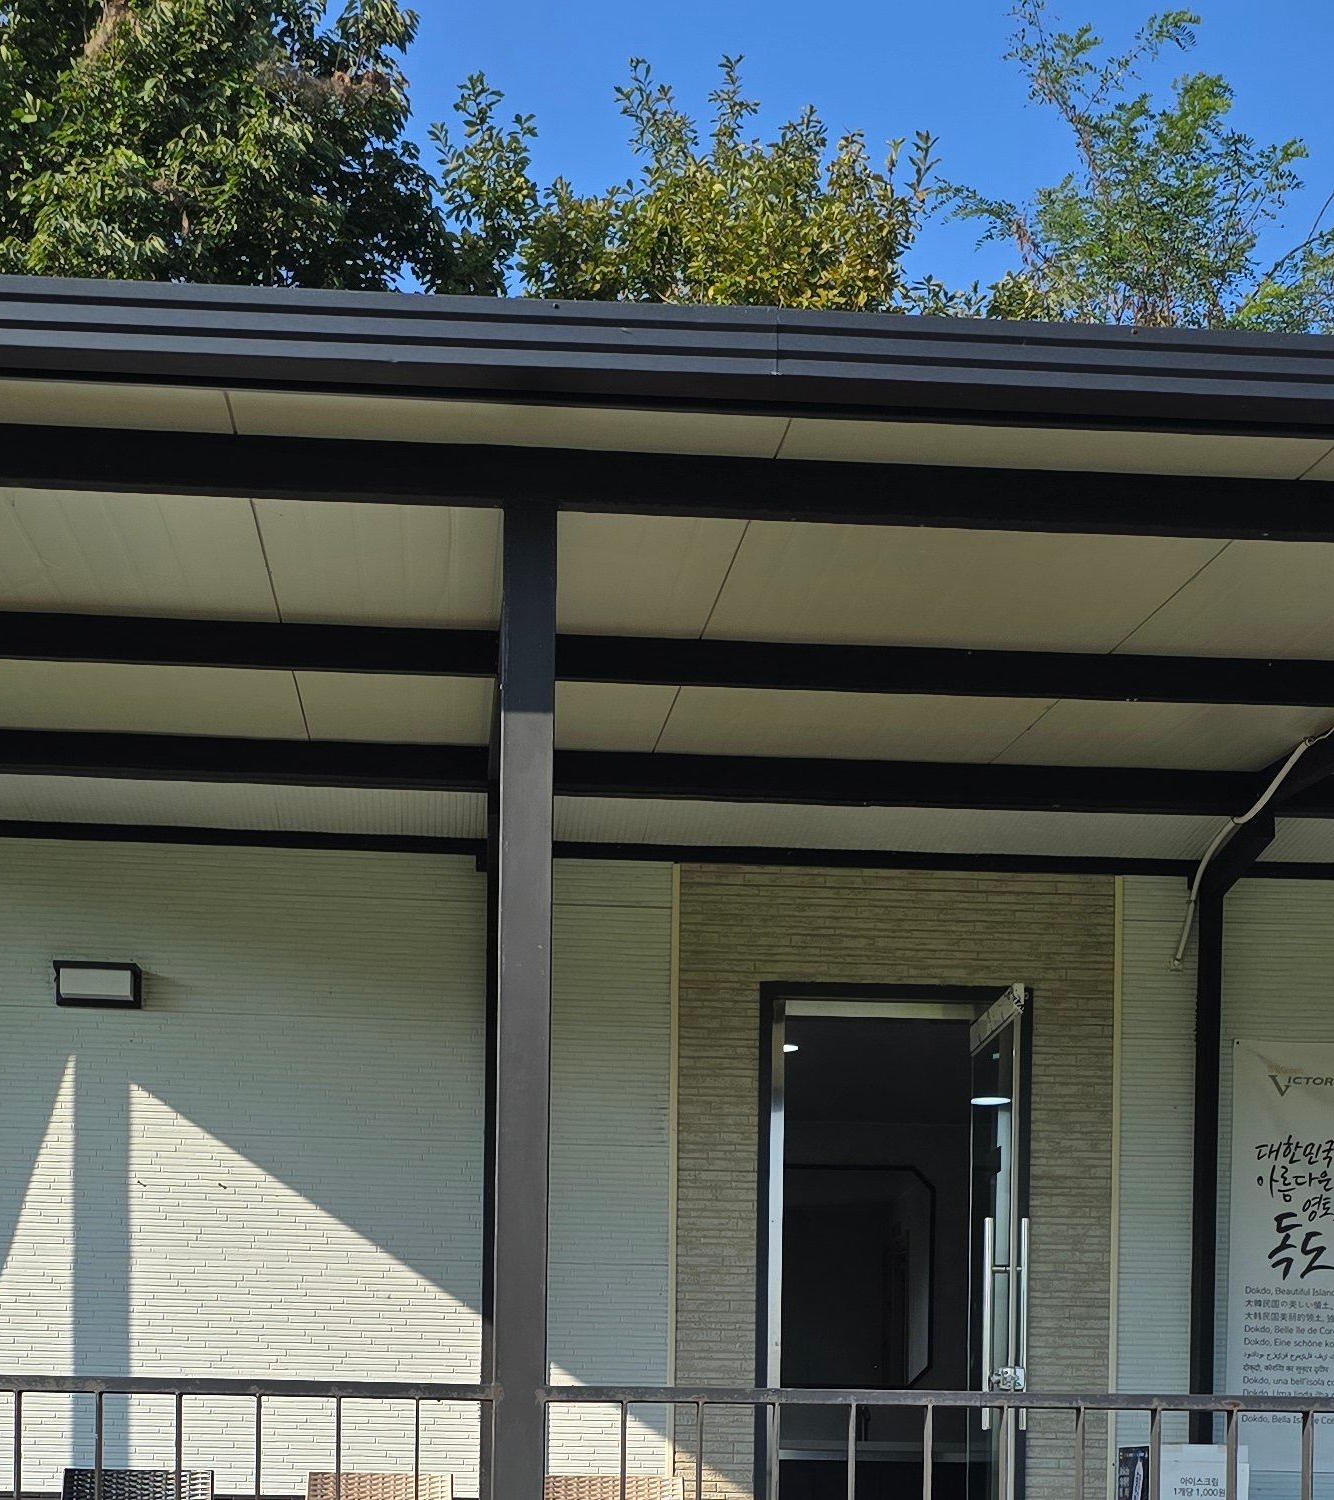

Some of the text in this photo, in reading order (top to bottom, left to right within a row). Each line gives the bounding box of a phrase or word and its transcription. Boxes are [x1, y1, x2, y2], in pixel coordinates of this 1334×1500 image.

[1256, 1164, 1334, 1203] 아름다운
[1245, 1285, 1274, 1296] Dokdo,
[1275, 1286, 1311, 1297] Beautiful
[1244, 1325, 1273, 1335] Dokdo,
[1274, 1325, 1294, 1335] Belle
[1307, 1326, 1318, 1335] de
[1243, 1337, 1273, 1347] Dokdo,
[1274, 1337, 1292, 1347] Eine
[1243, 1375, 1272, 1386] Dokdo,
[1272, 1378, 1289, 1386] una
[1241, 1414, 1270, 1424] Dokdo,
[1271, 1415, 1291, 1424] Bella
[1179, 1477, 1219, 1487] 아이스크림
[1173, 1487, 1194, 1497] 1개당
